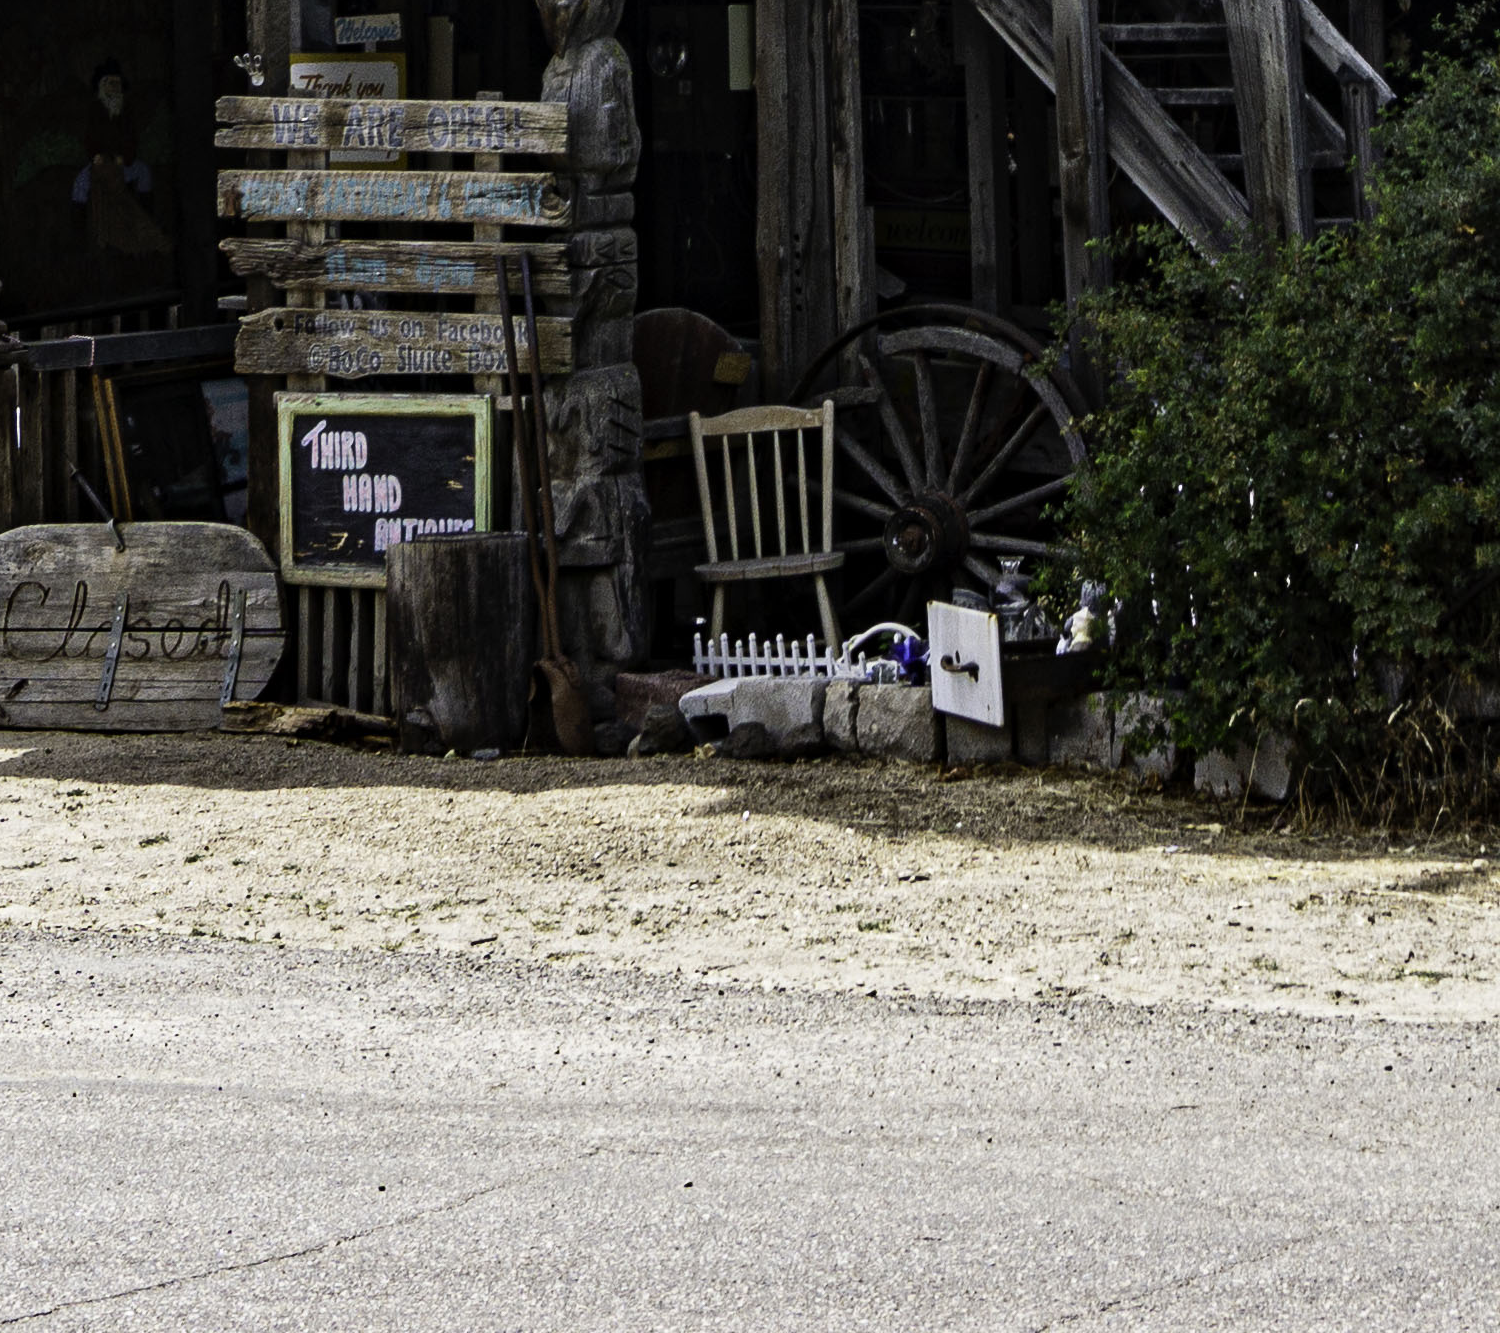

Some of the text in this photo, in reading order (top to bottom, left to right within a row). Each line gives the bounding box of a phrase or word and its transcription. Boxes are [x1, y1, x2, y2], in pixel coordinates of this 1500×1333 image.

[336, 18, 398, 42] Welcome
[272, 104, 522, 149] WE ARE OPEN!
[885, 212, 972, 244] welcom
[292, 314, 530, 347] Follow us on Facebok
[396, 345, 452, 374] Sluice
[466, 346, 509, 373] Box
[301, 420, 368, 470] THIRD
[343, 473, 402, 513] HAND
[3, 580, 233, 664] Closed
